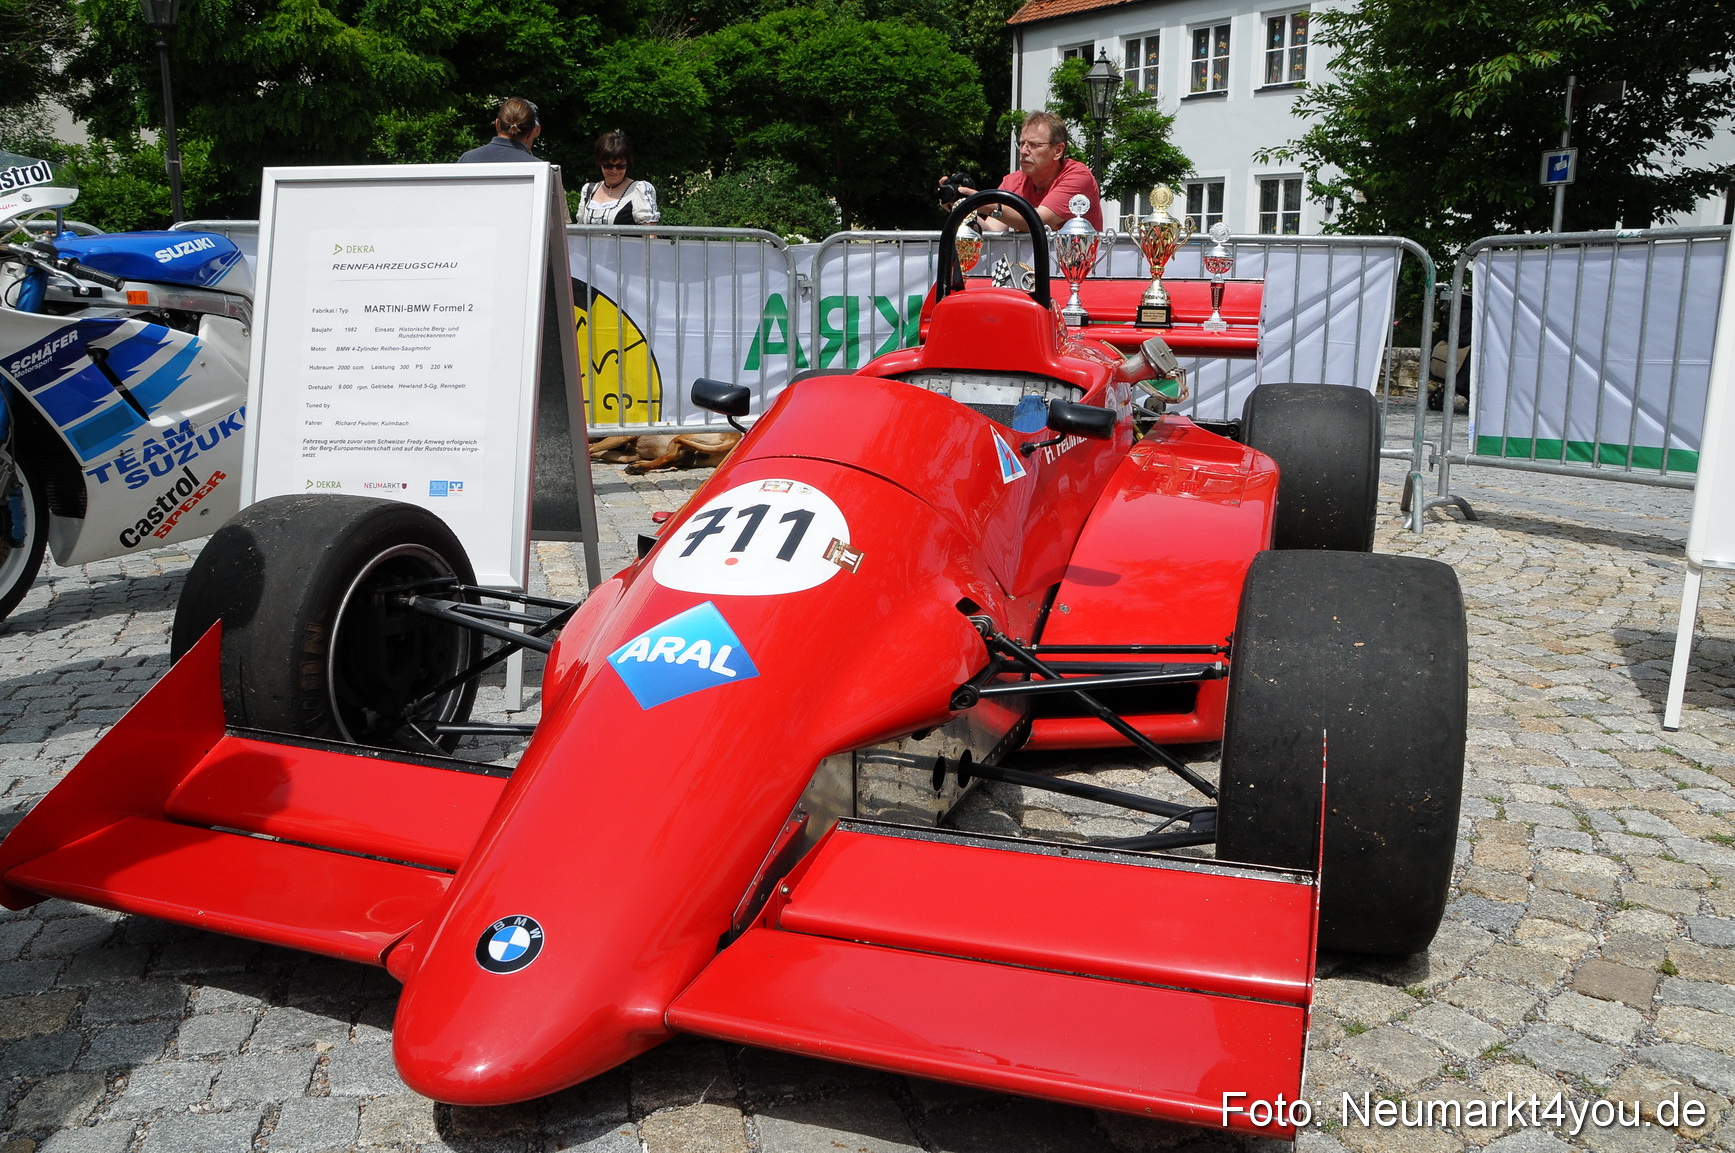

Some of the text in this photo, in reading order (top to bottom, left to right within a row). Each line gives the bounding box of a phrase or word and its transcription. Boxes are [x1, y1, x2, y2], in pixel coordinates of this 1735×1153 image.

[0, 161, 51, 189] strol
[155, 237, 215, 263] SUZUKI
[346, 245, 375, 253] DEKRA
[332, 261, 458, 270] RENNFAHRZEUGSCHAU
[364, 304, 431, 313] MARTINI-BMW
[433, 303, 465, 312] Formel
[468, 303, 474, 312] 2
[10, 329, 78, 374] SCHÄFER
[13, 355, 53, 379] Motorsport
[86, 419, 198, 484] TEAM
[119, 465, 201, 548] Castrol
[152, 470, 227, 539] SPEER
[679, 504, 816, 562] 711
[617, 636, 737, 678] ARAL
[492, 916, 542, 940] BMW
